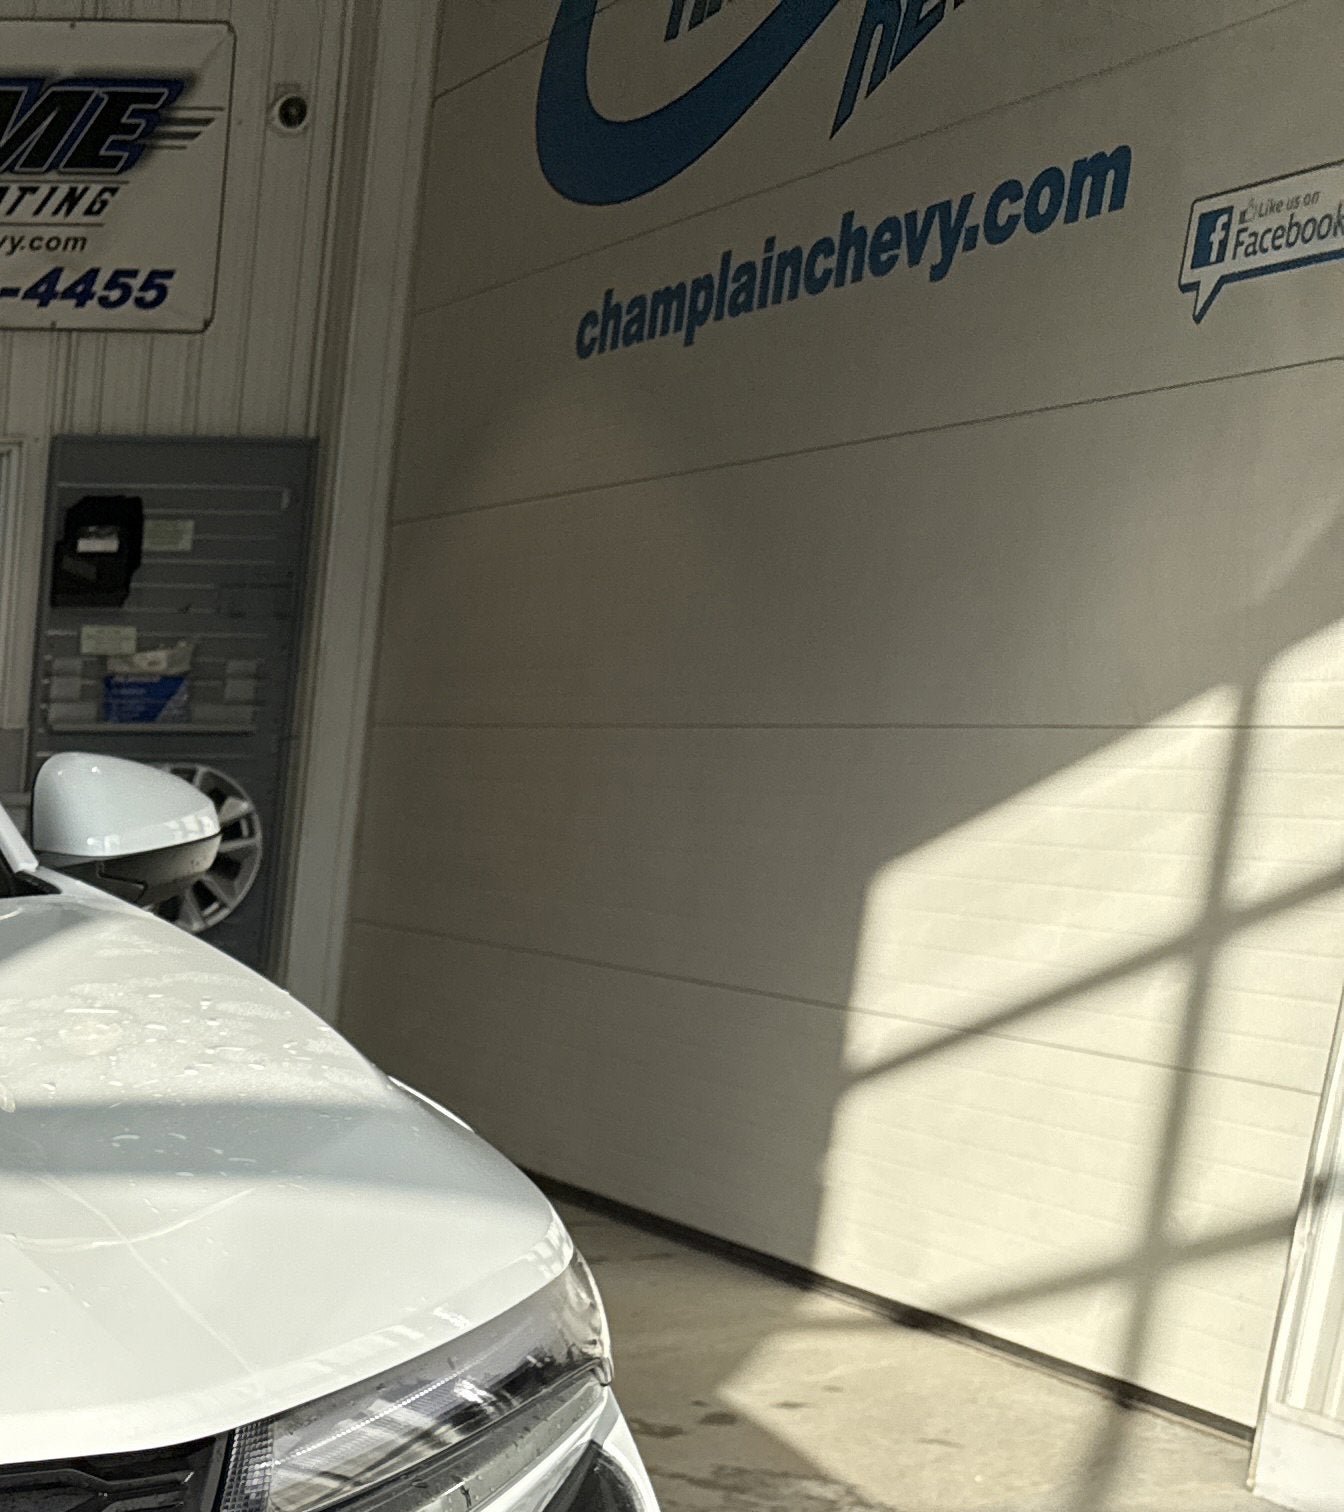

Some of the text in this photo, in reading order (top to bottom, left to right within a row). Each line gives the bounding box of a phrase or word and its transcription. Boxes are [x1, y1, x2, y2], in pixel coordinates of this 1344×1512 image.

[575, 144, 1133, 360] champlainchevy.com
[1258, 191, 1321, 218] Like us on
